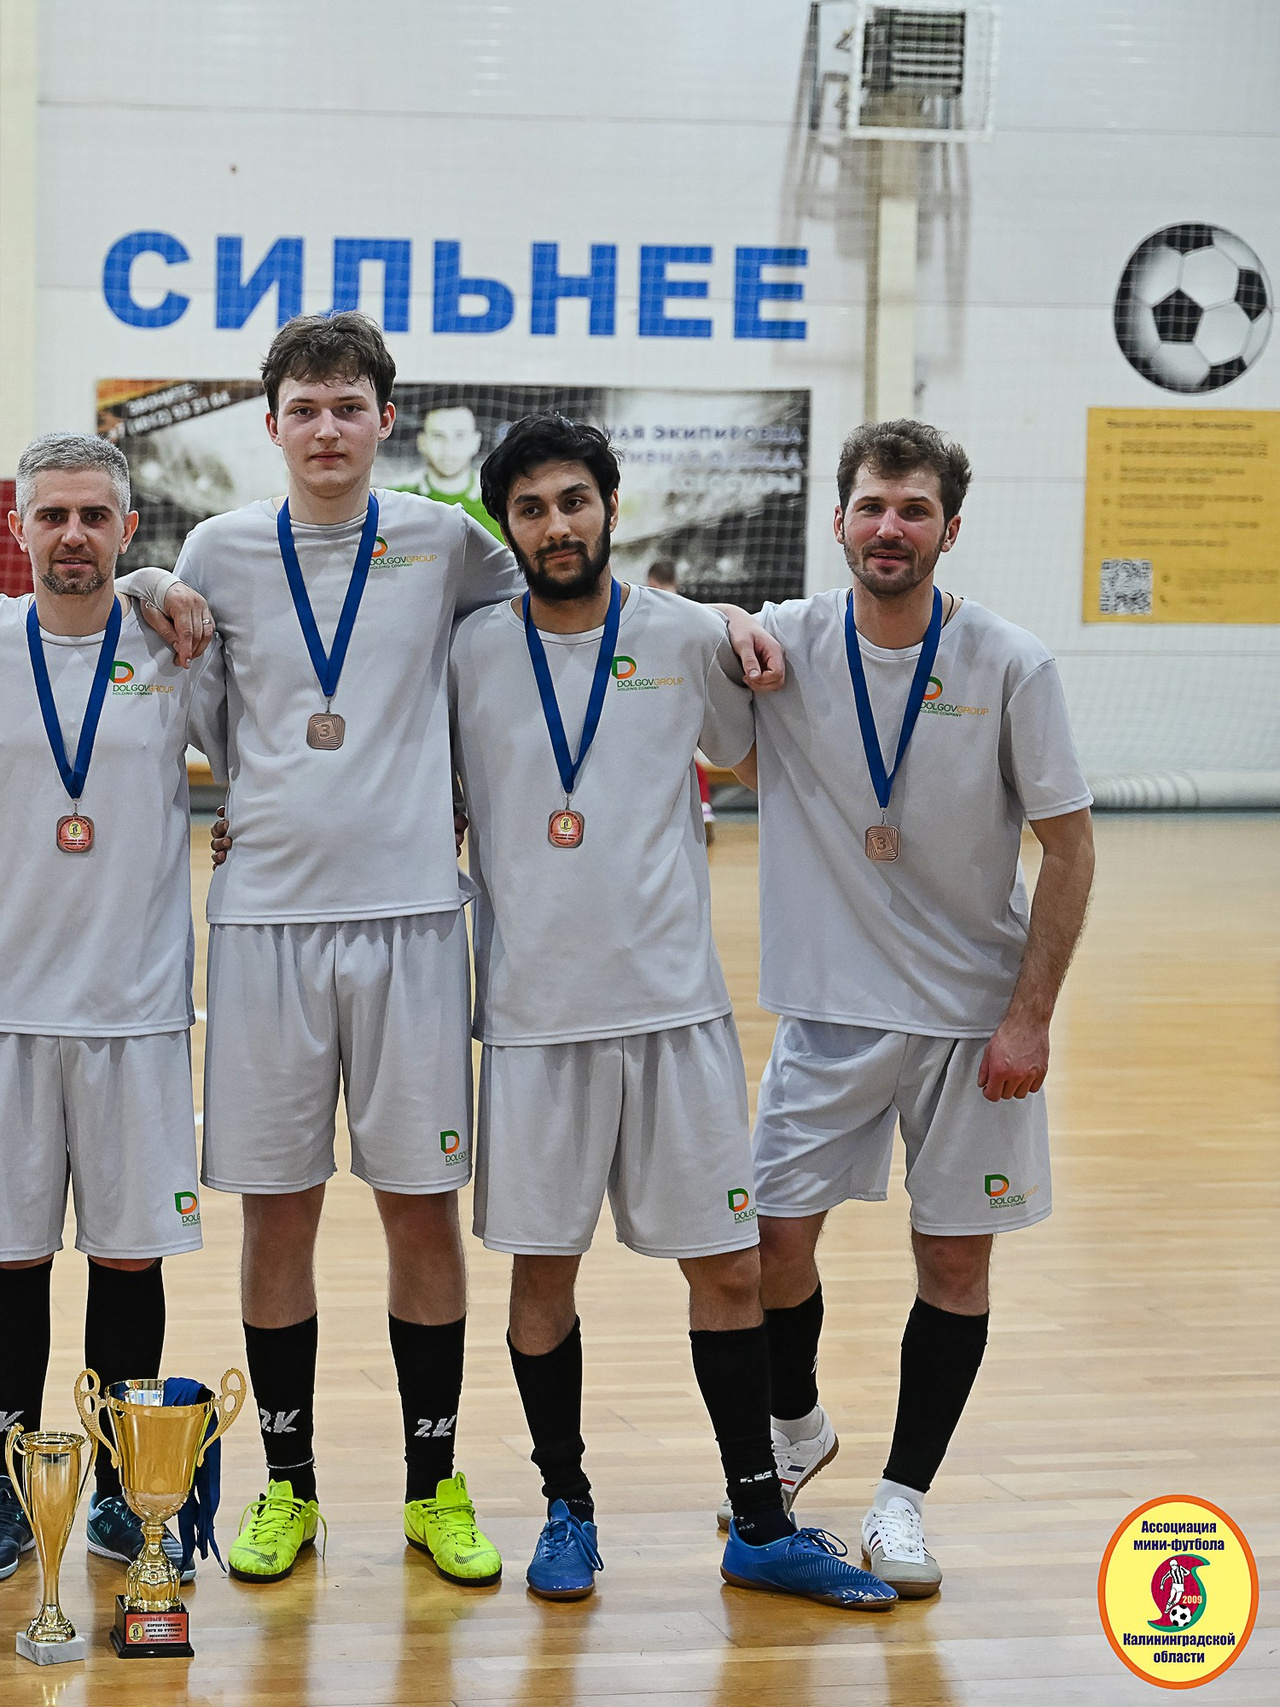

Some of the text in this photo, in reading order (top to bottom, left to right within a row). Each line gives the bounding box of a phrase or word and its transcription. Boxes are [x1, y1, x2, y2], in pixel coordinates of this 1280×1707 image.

[101, 229, 810, 341] СИЛЬНЕЕ
[617, 677, 685, 688] DOLGOVGROUP
[877, 836, 887, 851] 3
[260, 1407, 300, 1433] 2K
[414, 1415, 456, 1438] 2K
